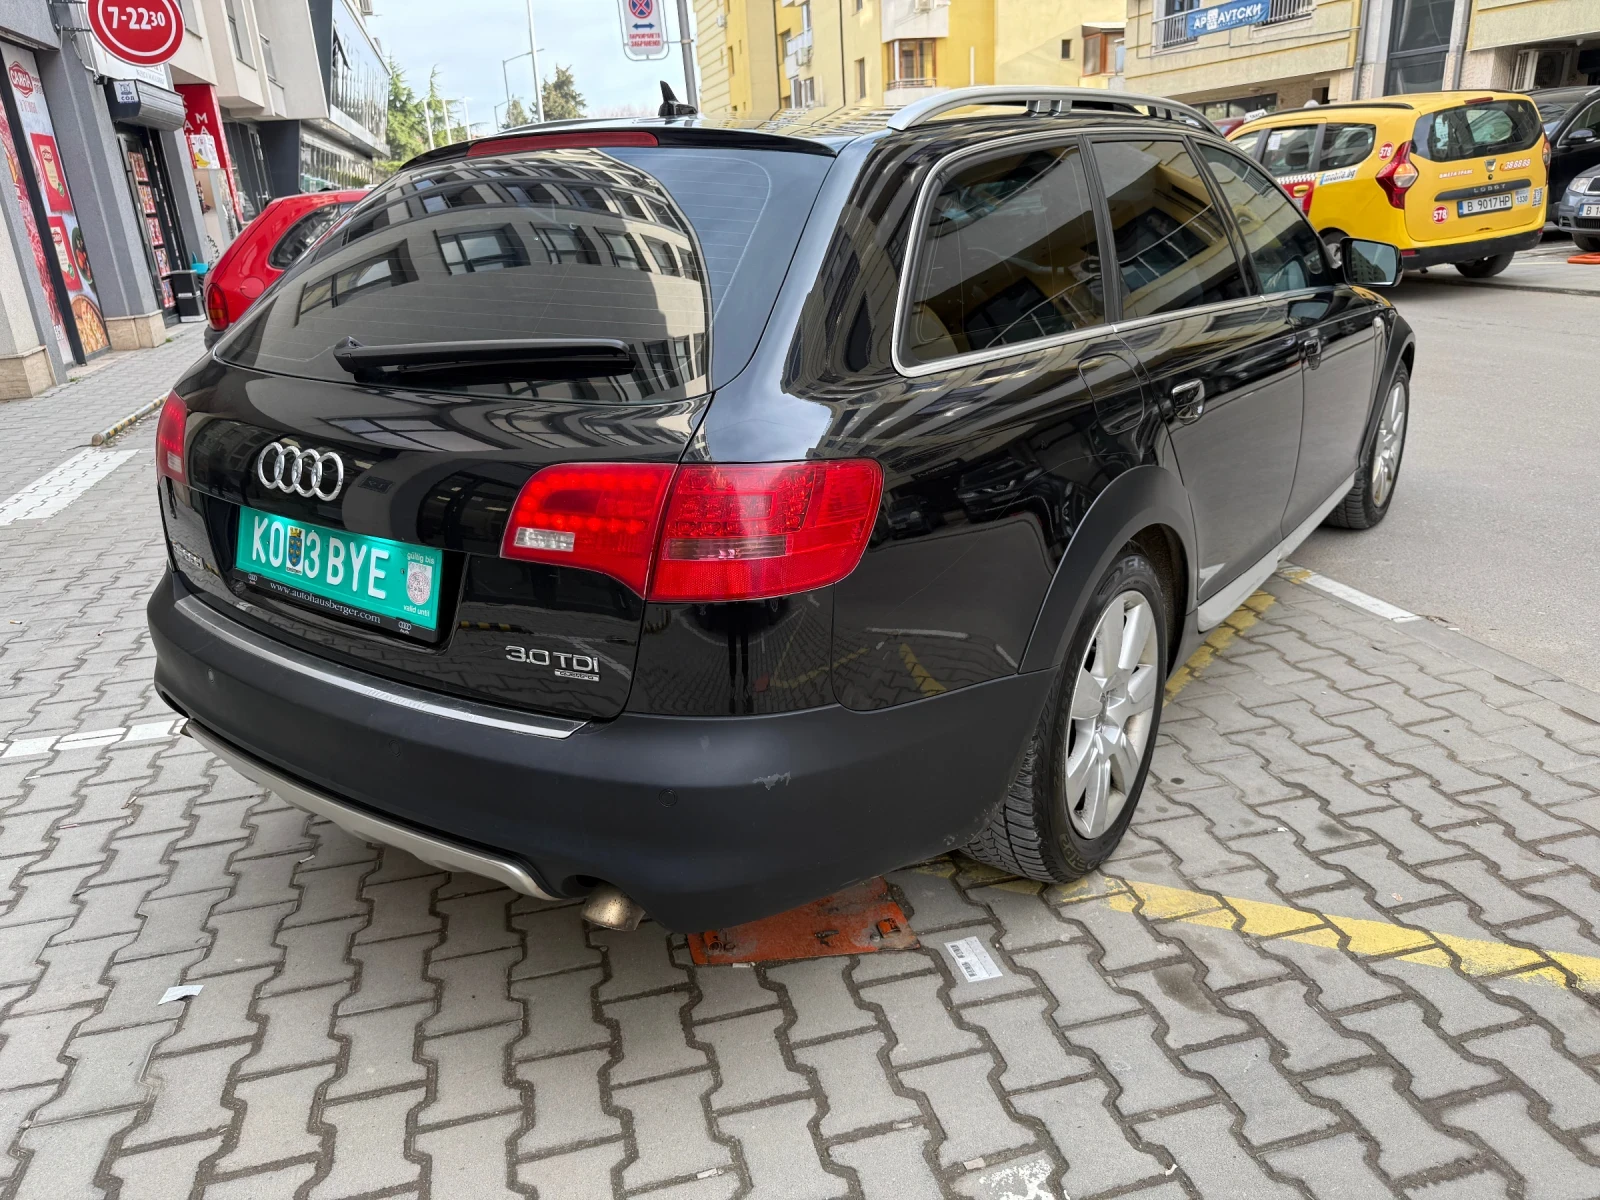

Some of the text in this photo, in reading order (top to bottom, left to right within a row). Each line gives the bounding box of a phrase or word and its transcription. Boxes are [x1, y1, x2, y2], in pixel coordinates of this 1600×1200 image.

[1379, 146, 1393, 158] 578
[1473, 183, 1506, 193] LODGY
[1433, 209, 1448, 220] 578
[1586, 205, 1592, 216] B
[407, 551, 435, 565] gültig bis
[269, 581, 381, 625] www.autohausberger.com
[403, 604, 430, 617] valid until
[505, 645, 550, 666] 3.0
